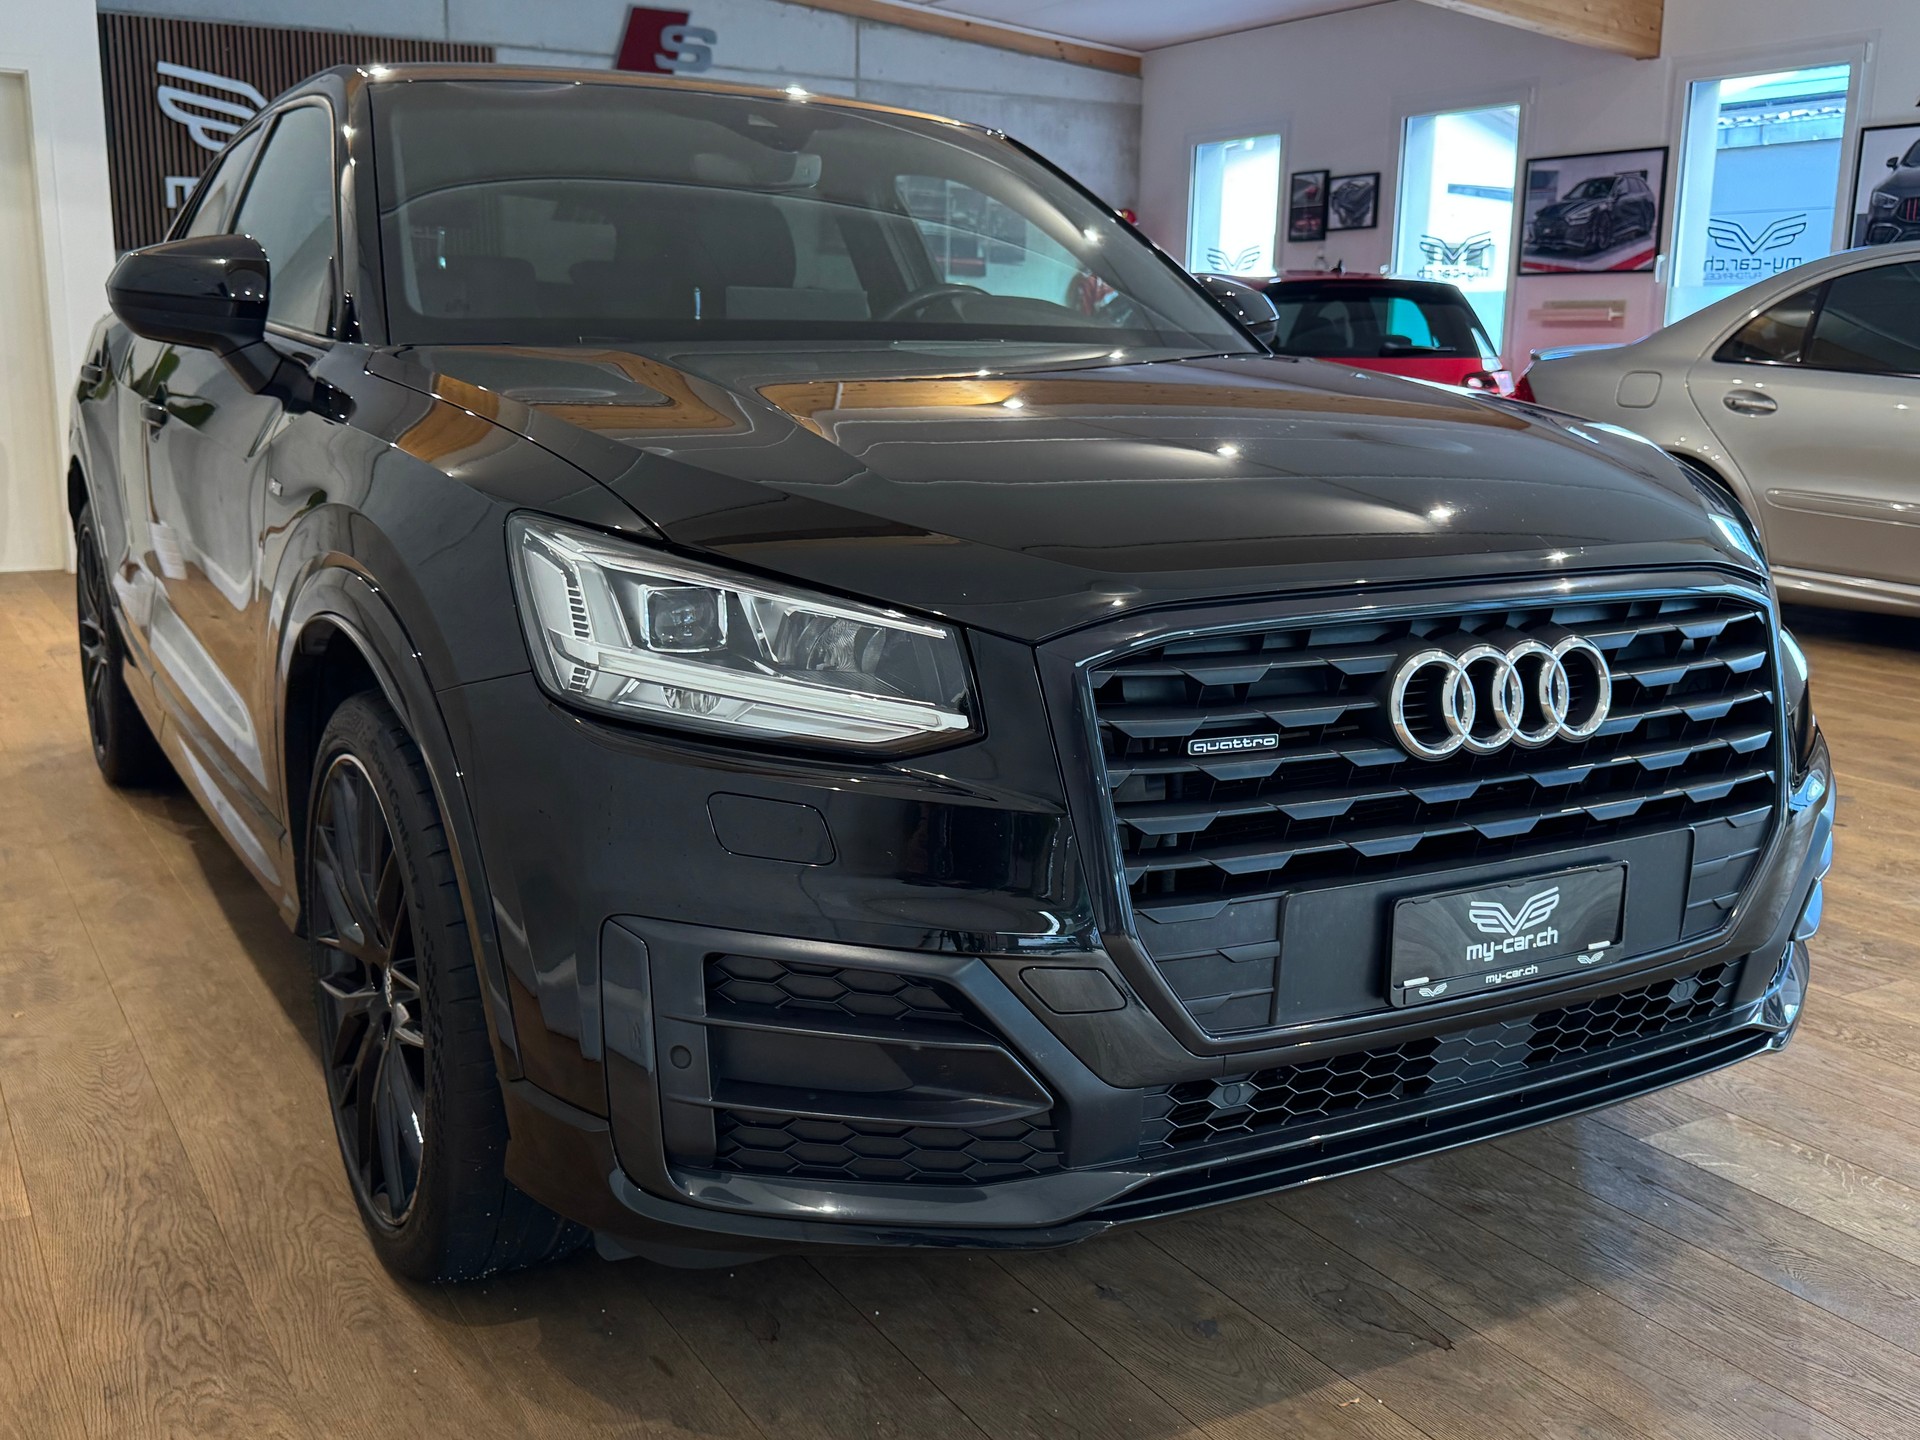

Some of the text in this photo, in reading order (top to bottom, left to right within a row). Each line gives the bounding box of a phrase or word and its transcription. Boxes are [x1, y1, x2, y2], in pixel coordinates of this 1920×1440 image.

[654, 24, 717, 73] S
[1194, 737, 1275, 752] quattro
[1466, 927, 1558, 962] my-car.ch
[1486, 965, 1538, 983] my-car.ch
